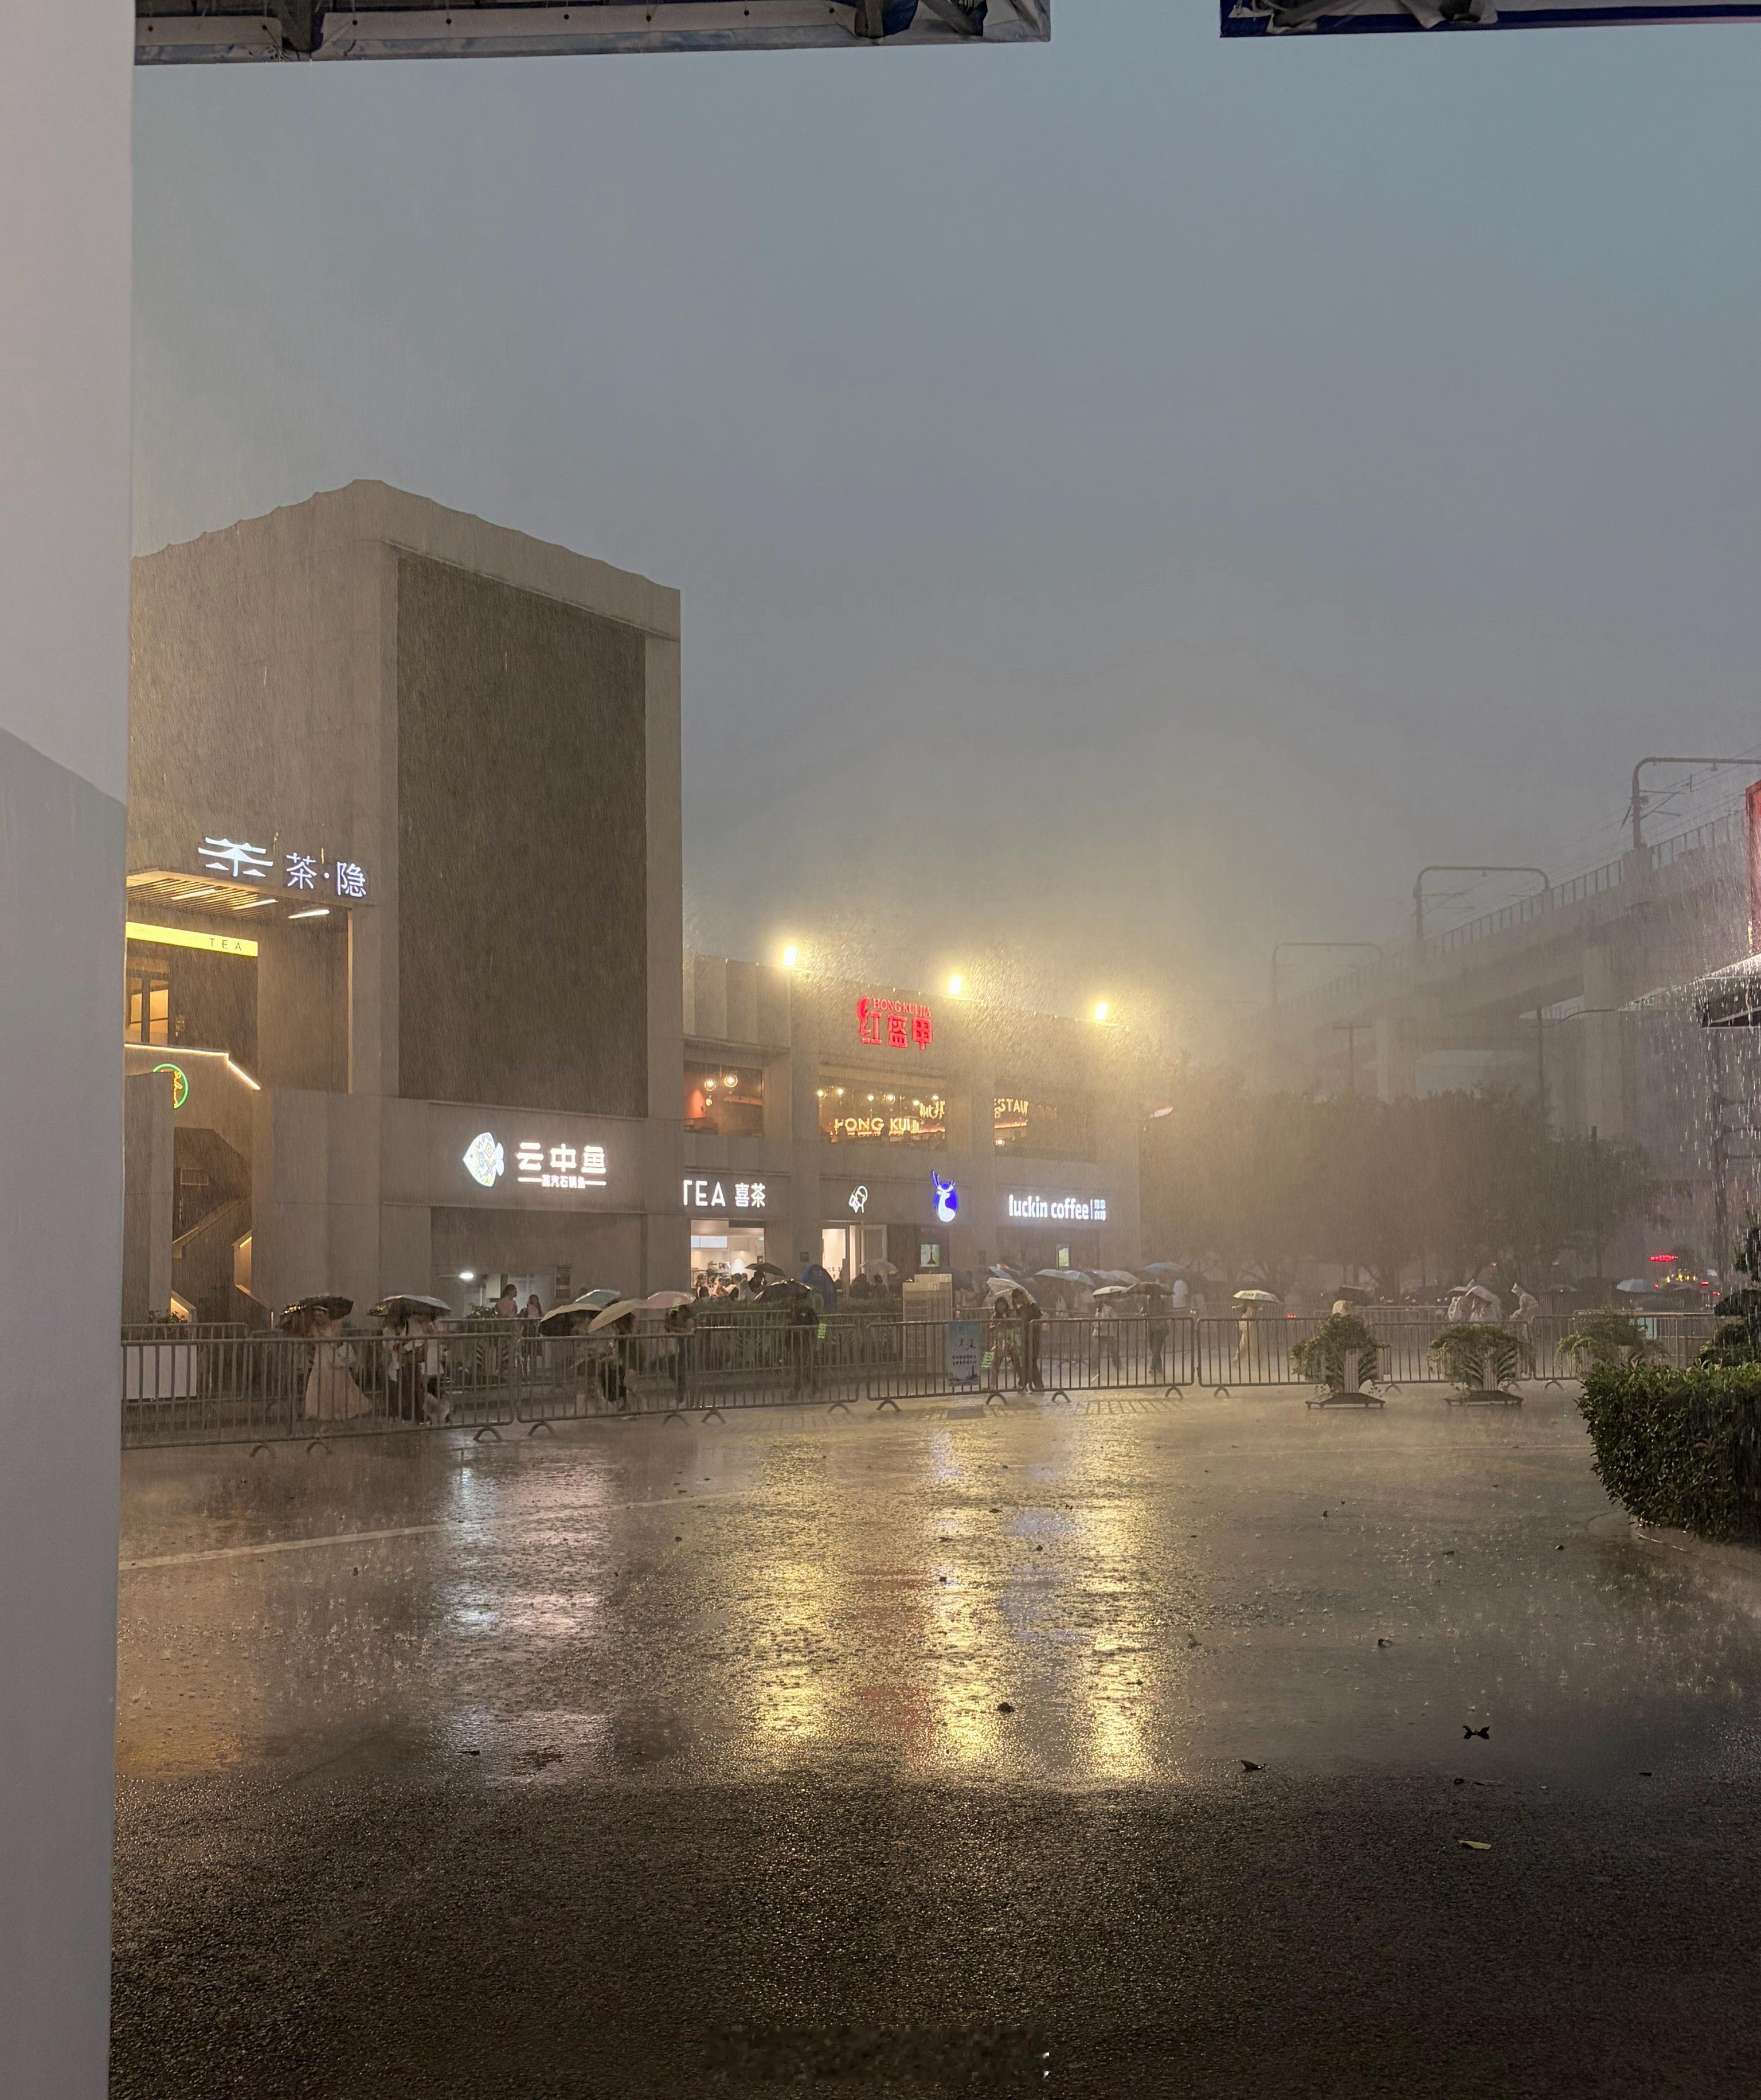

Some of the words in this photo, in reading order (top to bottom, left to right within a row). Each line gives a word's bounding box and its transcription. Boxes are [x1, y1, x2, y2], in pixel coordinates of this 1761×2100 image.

[209, 937, 242, 952] TEA
[872, 998, 901, 1013] HONG
[683, 1179, 726, 1207] TEA
[735, 1182, 766, 1208] 喜茶
[1009, 1194, 1048, 1218] luckin
[1051, 1198, 1089, 1220] coffee
